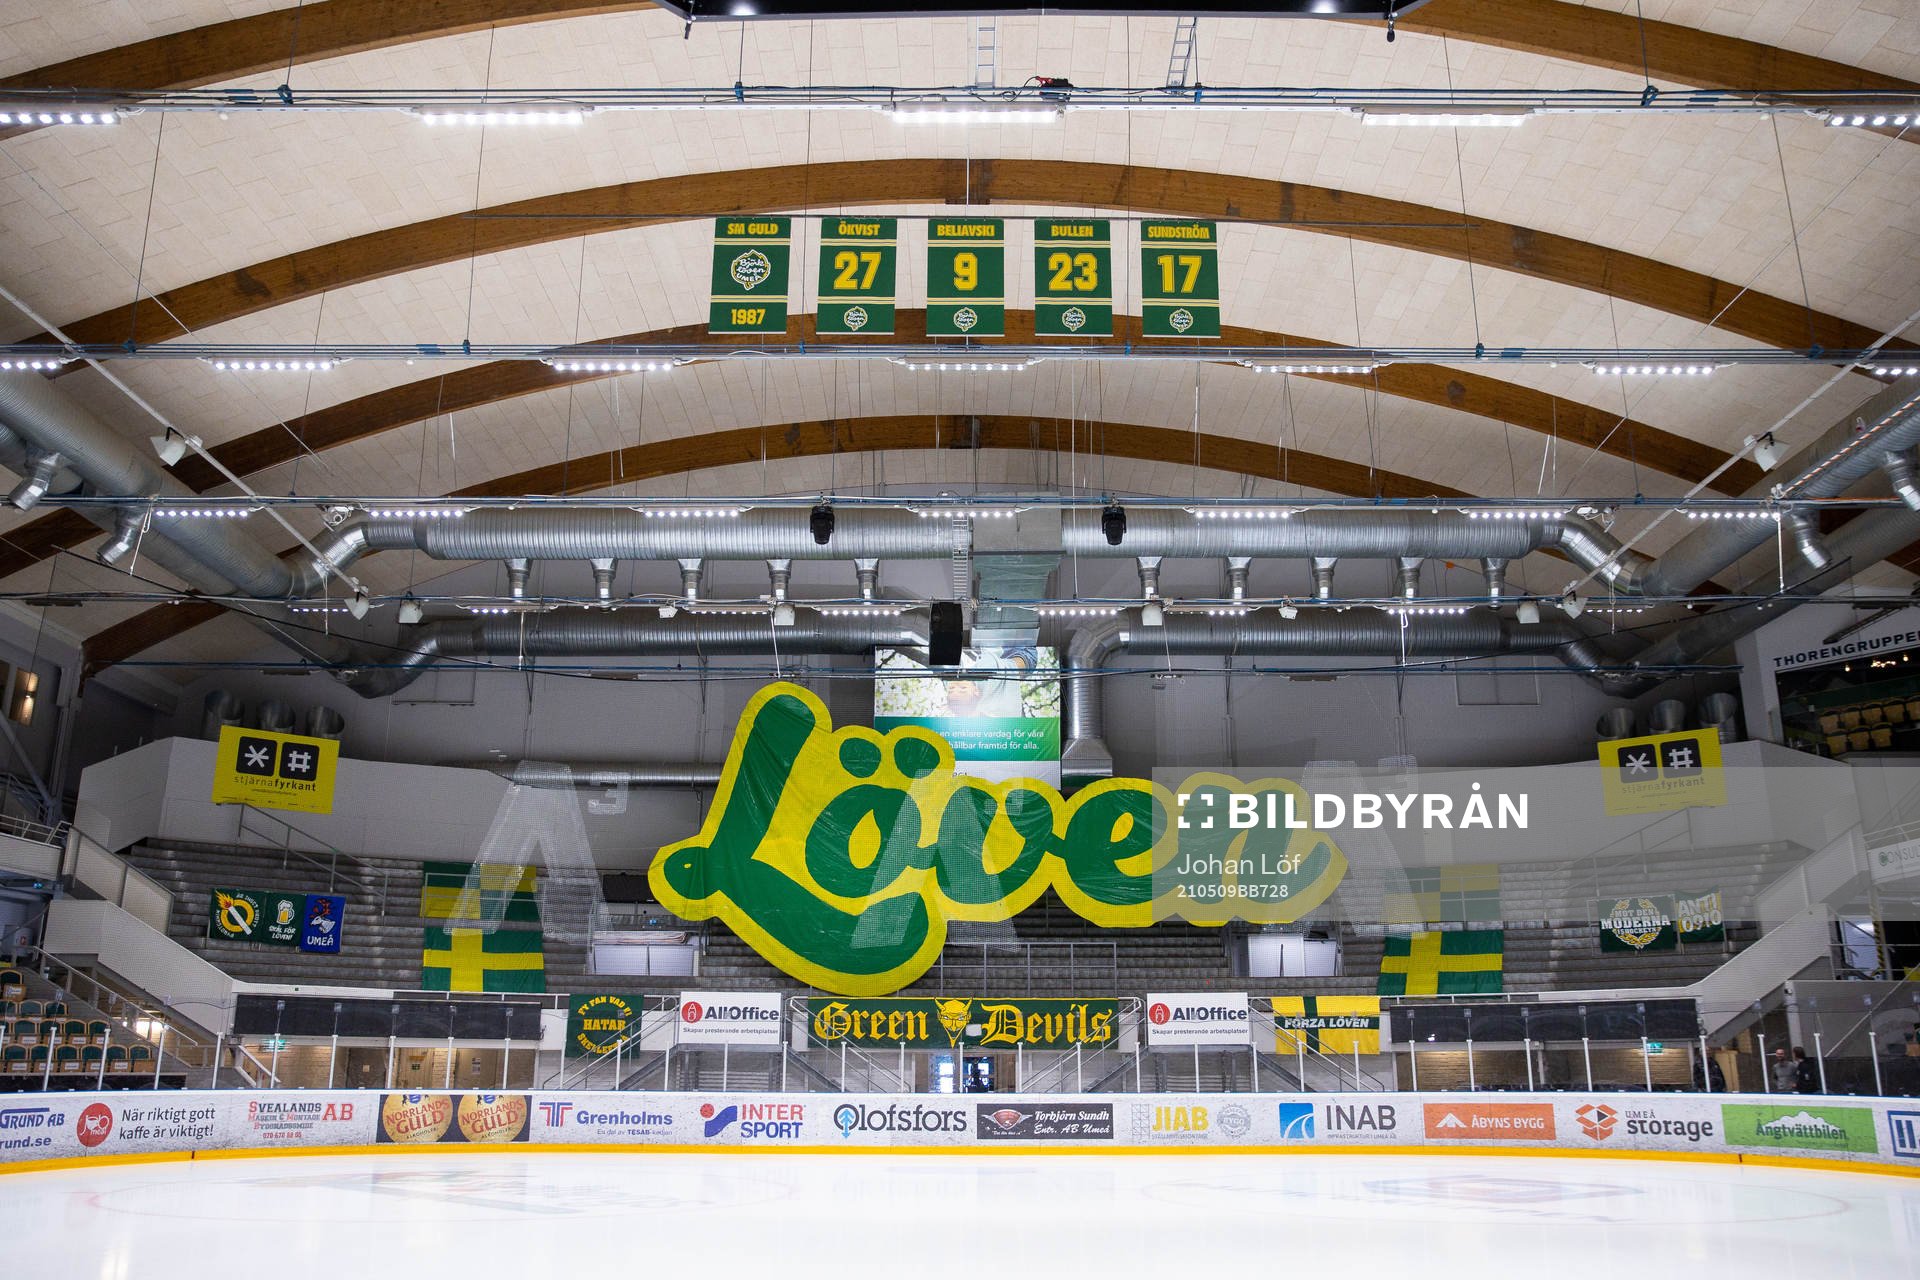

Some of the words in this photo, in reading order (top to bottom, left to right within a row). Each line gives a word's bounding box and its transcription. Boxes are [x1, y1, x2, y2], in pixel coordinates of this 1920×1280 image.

[727, 223, 745, 235] SM
[748, 223, 778, 235] GULD
[838, 220, 880, 236] ÖKVIST
[937, 224, 995, 237] BELIAVSKI
[1051, 225, 1094, 238] BULLEN
[1147, 224, 1210, 239] SUNDSTRÖM
[833, 251, 882, 290] 27
[953, 252, 978, 291] 9
[1048, 252, 1098, 291] 23
[1157, 255, 1202, 293] 17
[731, 308, 766, 325] 1987
[1773, 631, 1920, 667] THORENGRUPPE
[1014, 729, 1025, 738] för
[979, 741, 1008, 749] framtid
[1010, 741, 1021, 749] för
[655, 686, 1342, 990] Löven
[1680, 893, 1717, 917] ANTI
[1615, 910, 1634, 918] MOT
[1636, 909, 1654, 917] DEN
[1681, 909, 1721, 933] 0910
[284, 926, 296, 934] FÖR
[1600, 915, 1671, 929] MODERNA
[307, 935, 334, 946] UMEÅ
[589, 996, 607, 1007] FAN
[609, 996, 626, 1008] VAD
[704, 1006, 780, 1021] AllOffice
[1172, 1006, 1248, 1021] AllOffice
[813, 1001, 929, 1041] Green
[980, 1003, 1113, 1046] Devils
[1284, 1018, 1326, 1029] FORZA
[1329, 1015, 1370, 1029] LÖVEN
[122, 1109, 145, 1122] När
[147, 1107, 186, 1123] riktigt
[189, 1107, 216, 1123] gott
[249, 1101, 322, 1113] SVEALANDS
[322, 1103, 354, 1121] AB
[386, 1099, 450, 1126] NORRLANDS
[461, 1099, 525, 1126] NORRLANDS
[577, 1110, 673, 1125] Grenholms
[742, 1103, 803, 1120] INTER
[833, 1103, 967, 1132] Olofsfors
[1034, 1110, 1076, 1122] Torbjörn
[1077, 1110, 1110, 1121] Sundh
[1152, 1106, 1209, 1131] JIAB
[1326, 1105, 1397, 1130] INAB
[1625, 1109, 1656, 1119] UMEÅ
[47, 1113, 65, 1127] AB
[396, 1110, 445, 1134] GULD
[471, 1110, 519, 1134] GULD
[1471, 1114, 1511, 1128] ÅBYNS
[1514, 1117, 1545, 1129] BYGG
[119, 1126, 150, 1140] kaffe
[153, 1126, 167, 1138] är
[169, 1124, 214, 1138] viktigt!
[740, 1121, 803, 1139] SPORT
[1061, 1123, 1080, 1134] AB
[1082, 1123, 1110, 1134] Umeå
[1627, 1120, 1713, 1142] storage
[1756, 1118, 1847, 1140] Ångtvättbilen
